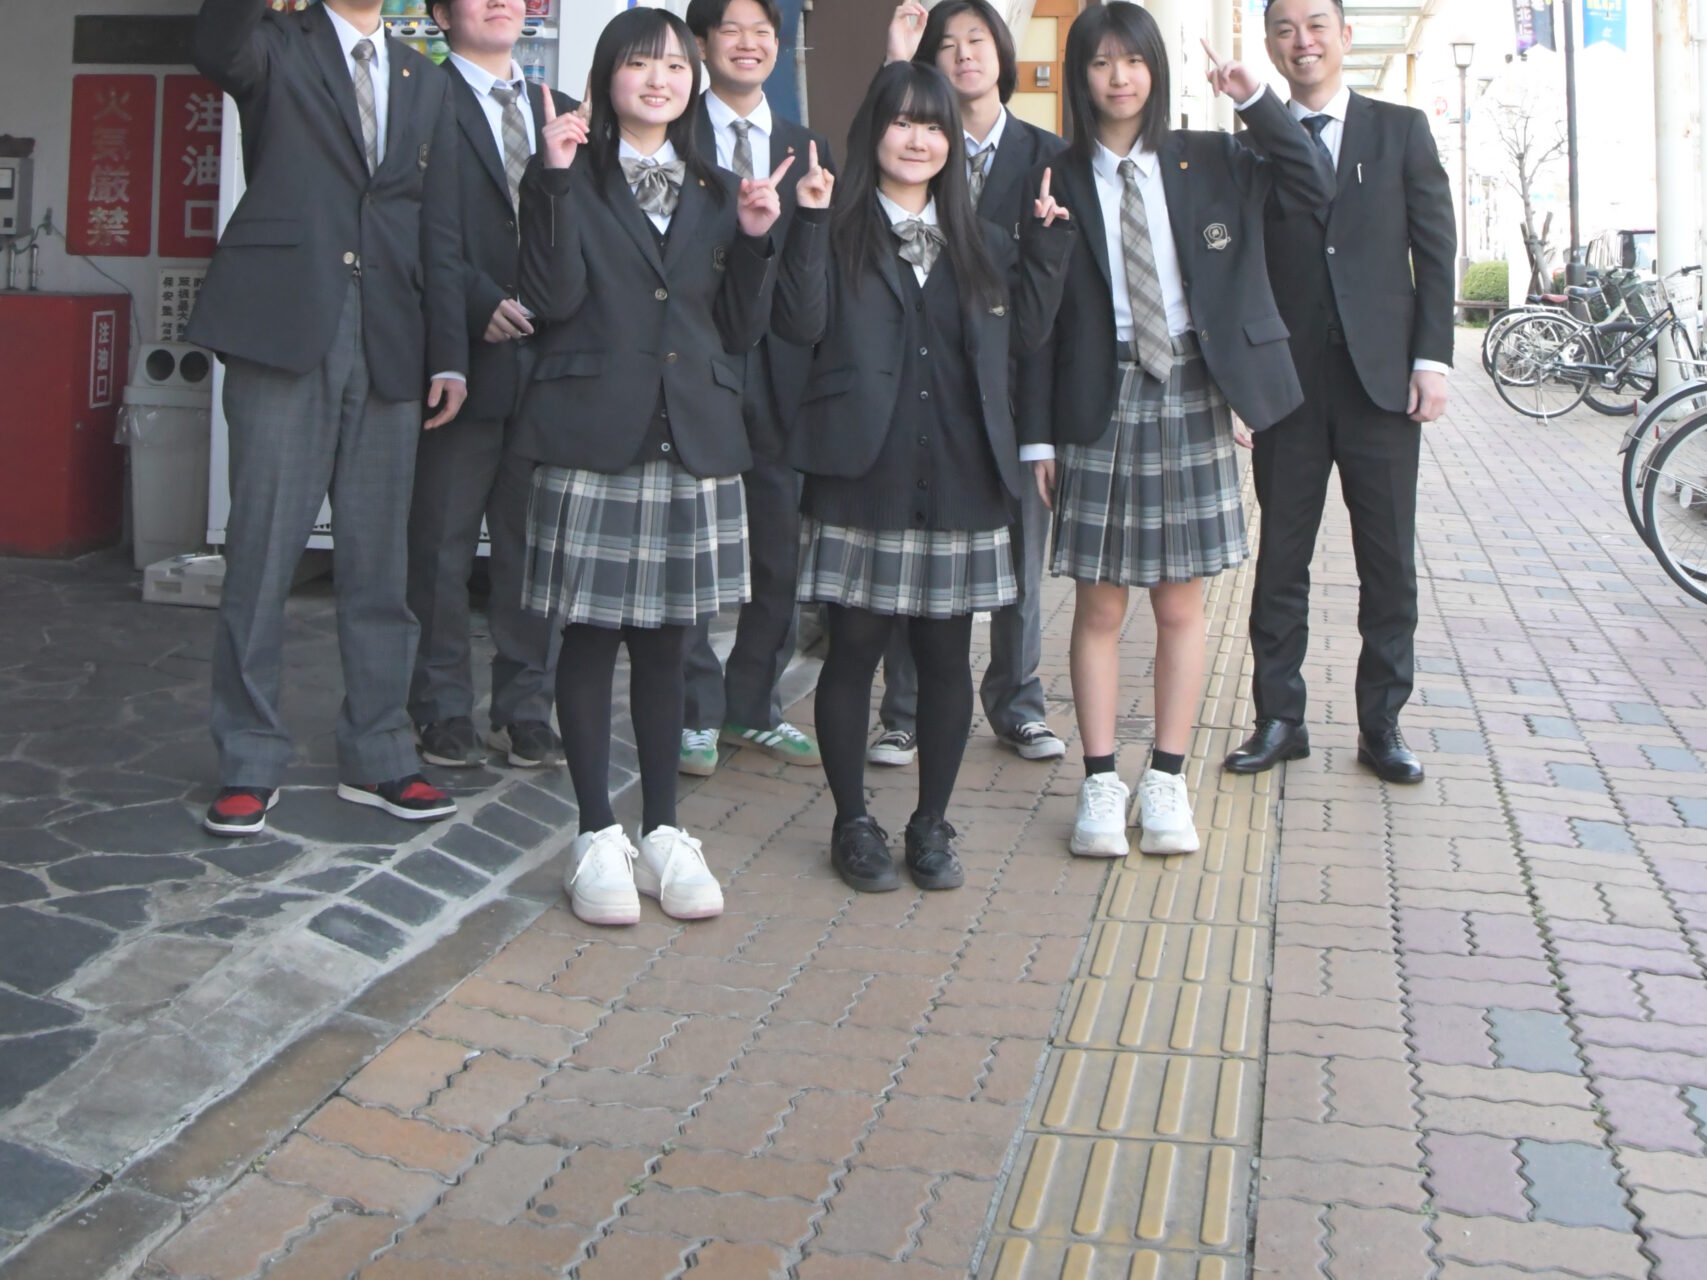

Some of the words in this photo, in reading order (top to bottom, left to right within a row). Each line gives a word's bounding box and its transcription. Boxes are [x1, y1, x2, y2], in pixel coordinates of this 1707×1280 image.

[87, 86, 132, 247] 火気厳禁
[182, 93, 223, 239] 注油口
[96, 321, 110, 397] 注油口
